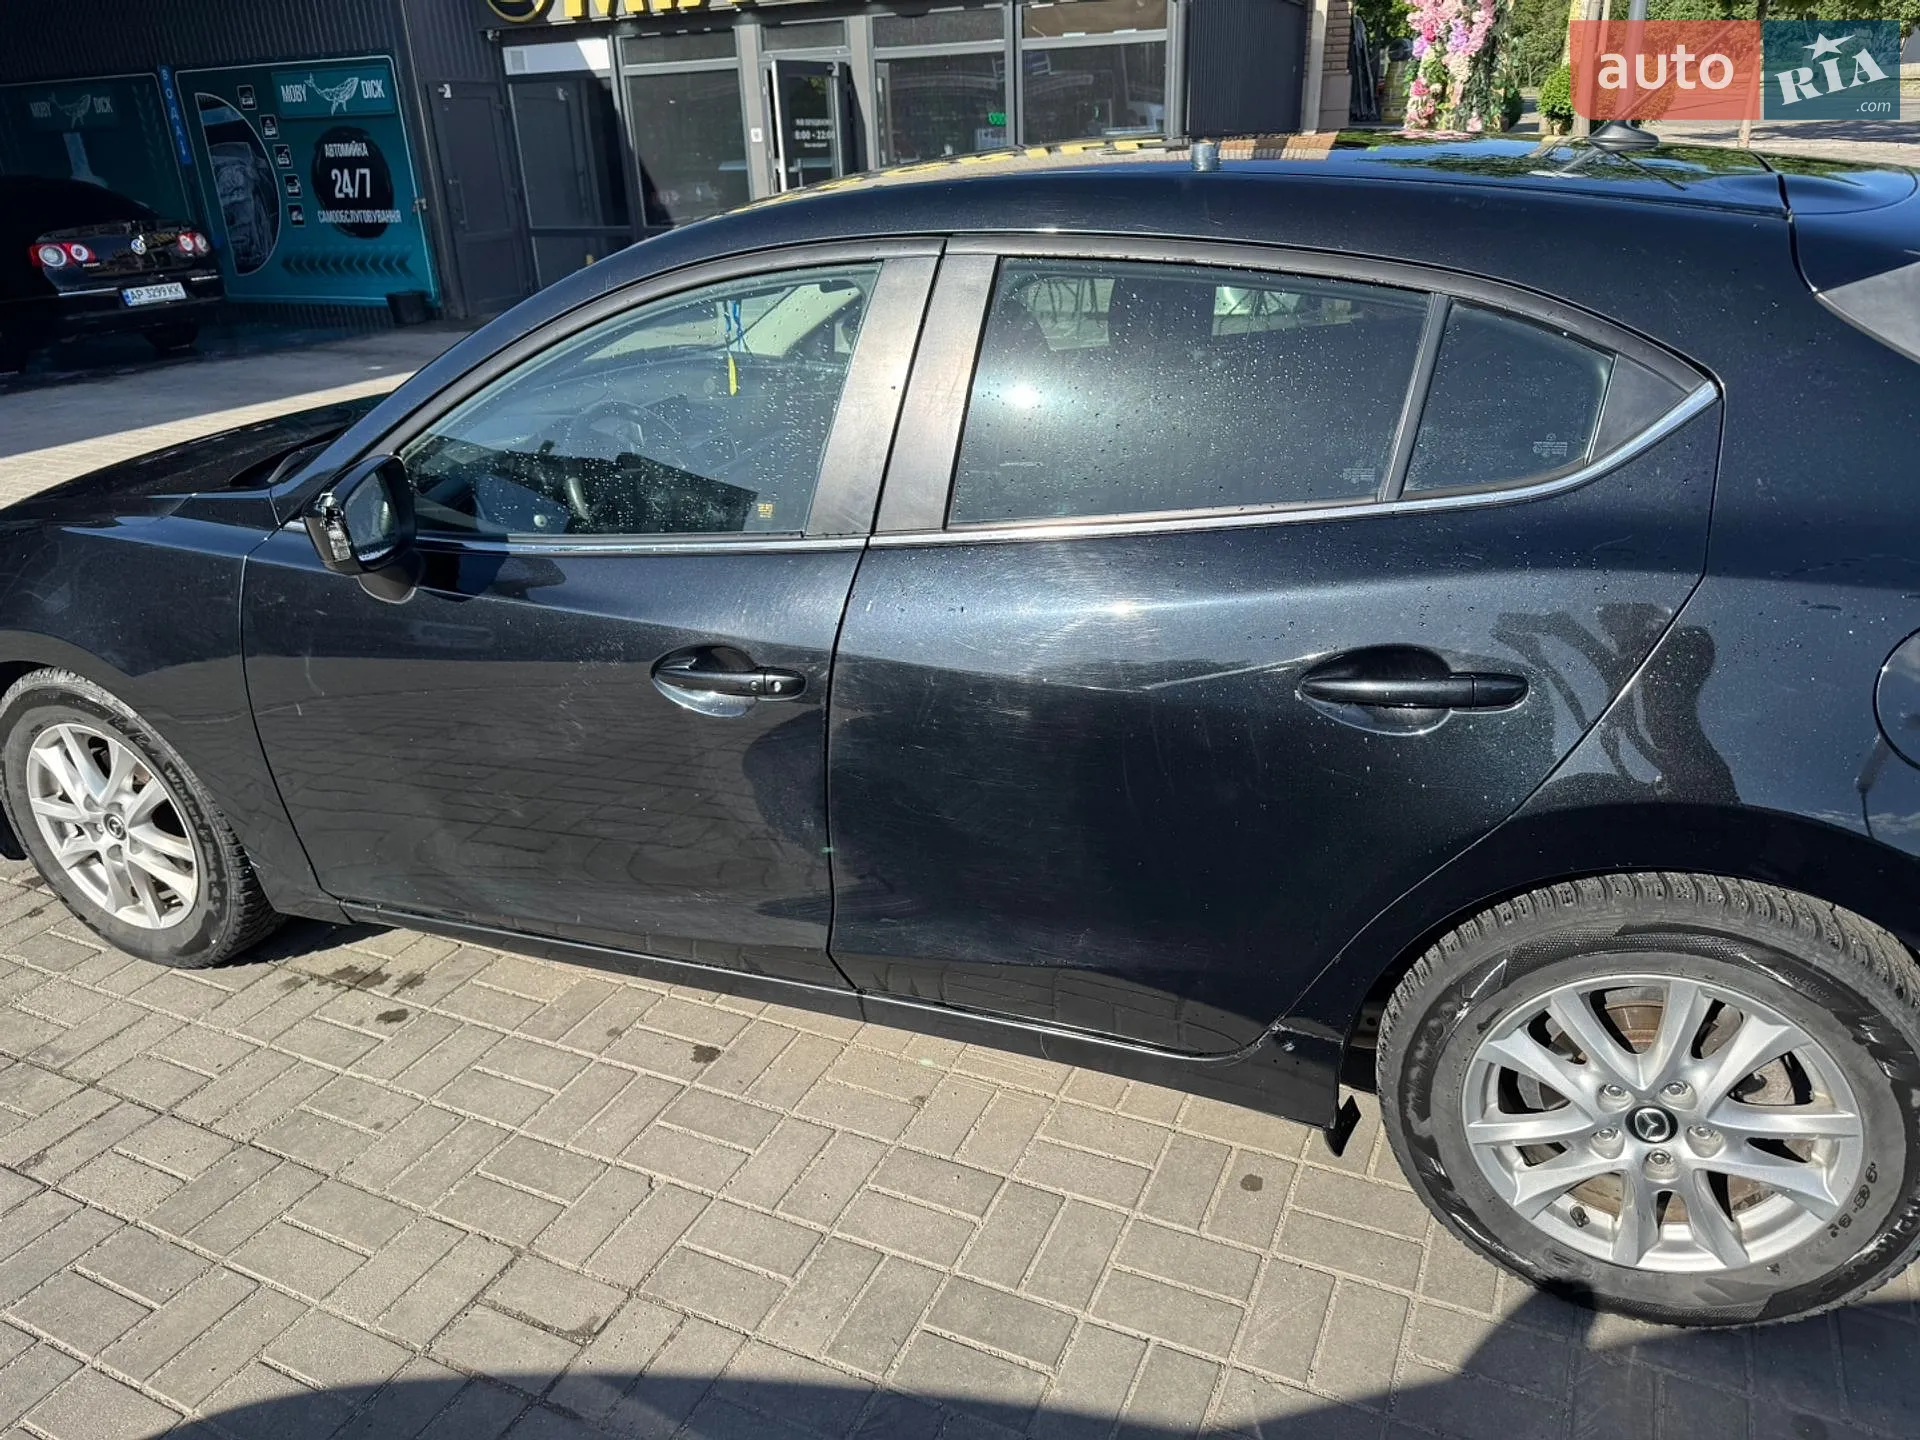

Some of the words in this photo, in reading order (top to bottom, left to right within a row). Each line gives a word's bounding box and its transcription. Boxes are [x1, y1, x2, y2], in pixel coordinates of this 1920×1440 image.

[280, 83, 307, 103] MOBY
[360, 79, 386, 99] DICK
[324, 140, 369, 158] АВТОМИЙКА
[331, 168, 371, 199] 24/7
